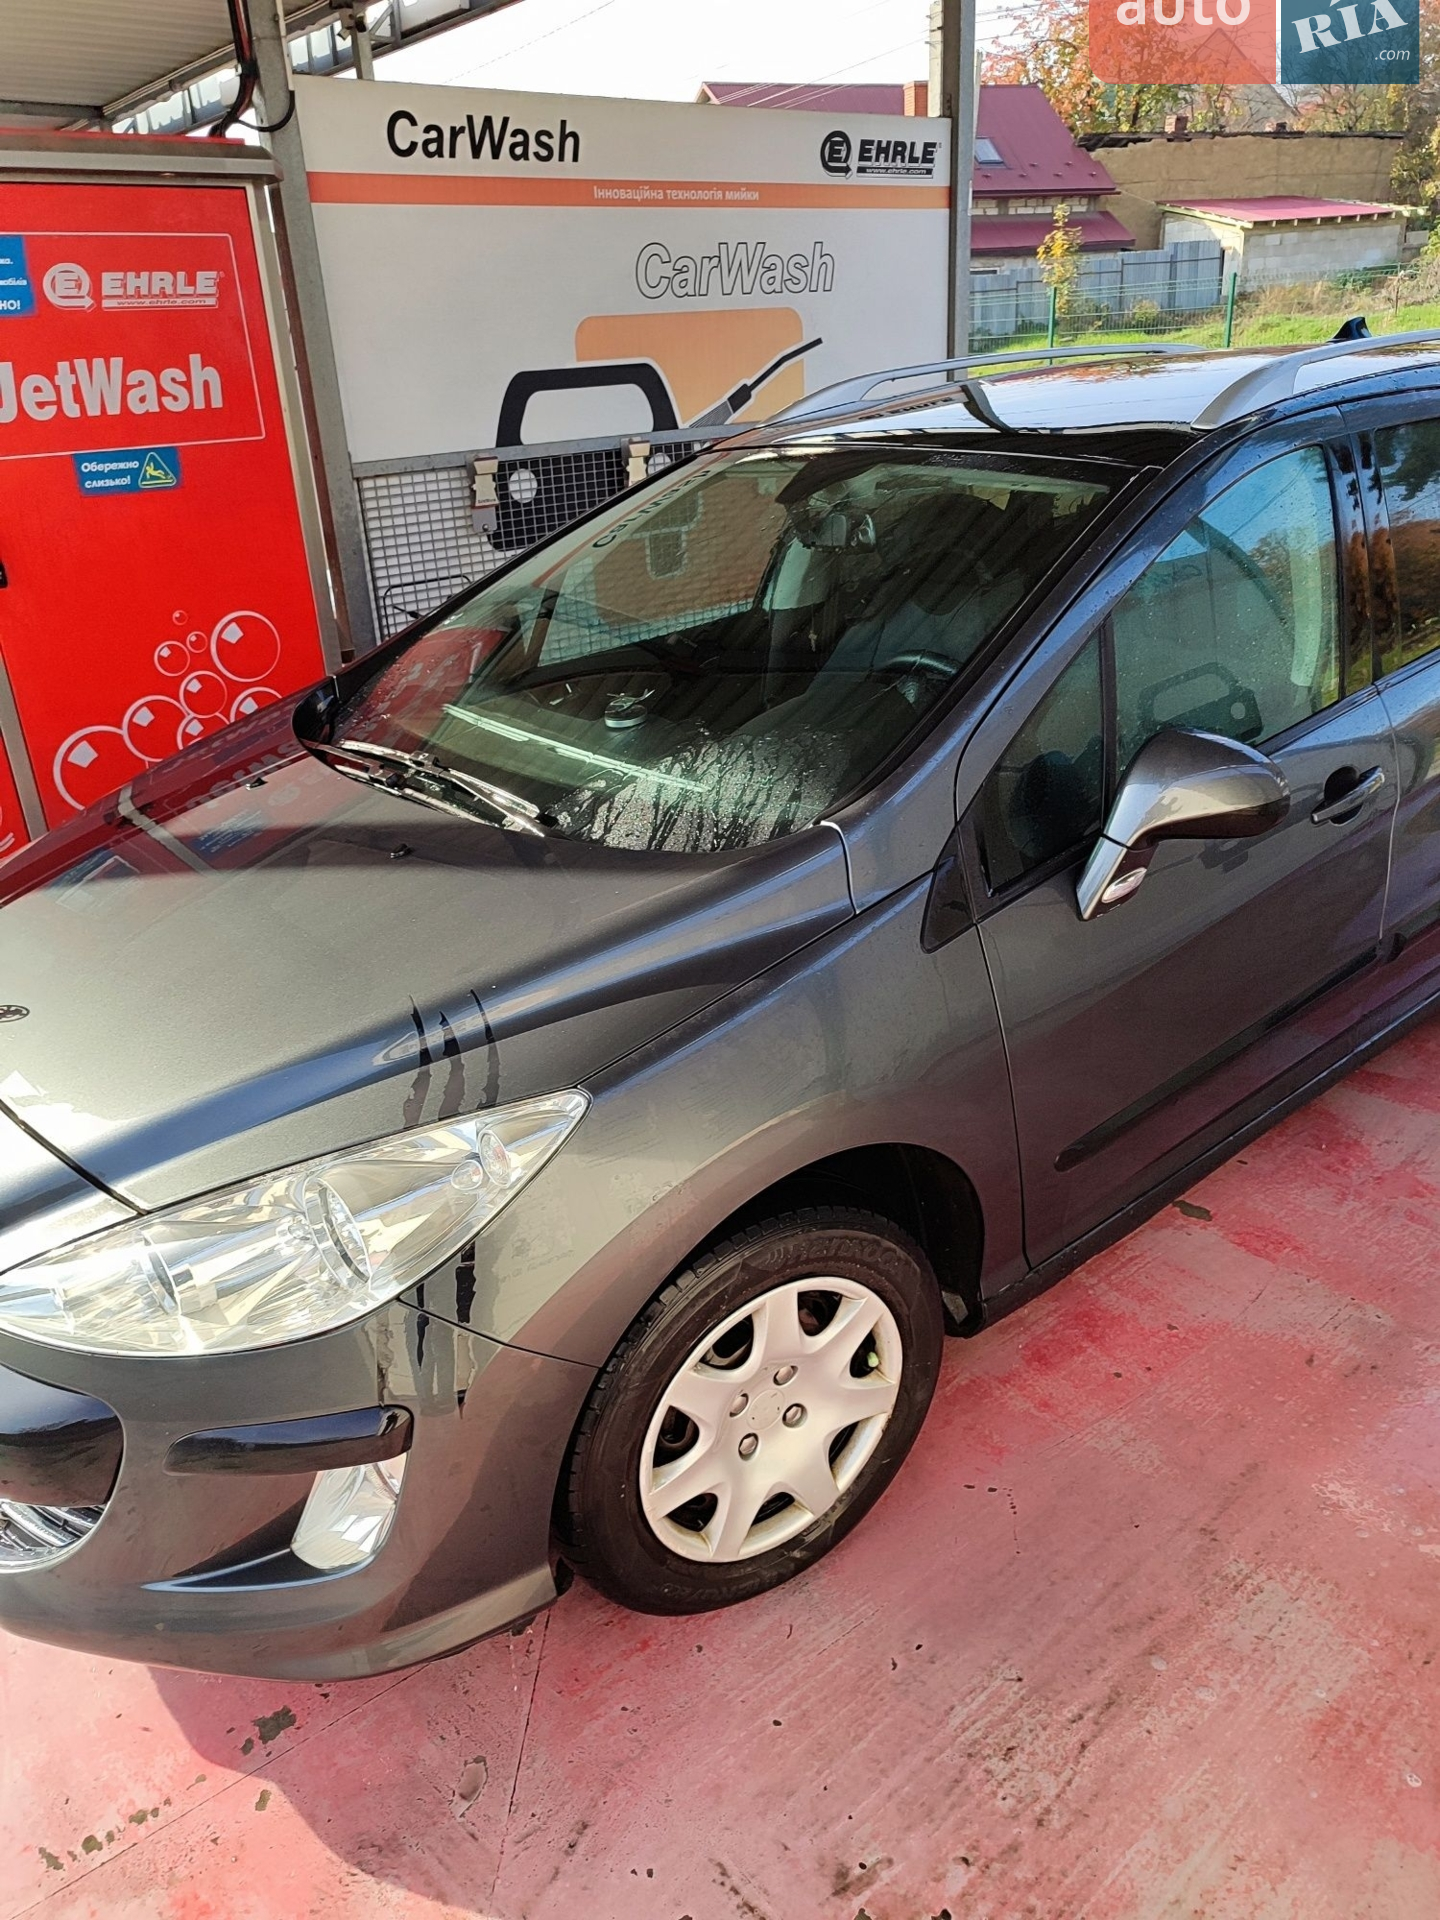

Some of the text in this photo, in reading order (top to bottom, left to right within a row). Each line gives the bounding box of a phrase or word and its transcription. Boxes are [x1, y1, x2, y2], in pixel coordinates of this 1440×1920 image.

[387, 110, 580, 162] CarWash
[858, 139, 938, 166] EHRLE
[865, 167, 927, 175] www.ehrle.com
[593, 185, 759, 202] Інноваційна технологія мийки
[636, 241, 835, 299] CarWash
[102, 271, 218, 298] EHRLE
[0, 353, 223, 423] JetWash
[81, 461, 140, 473] Обережно
[84, 475, 131, 488] слизько!
